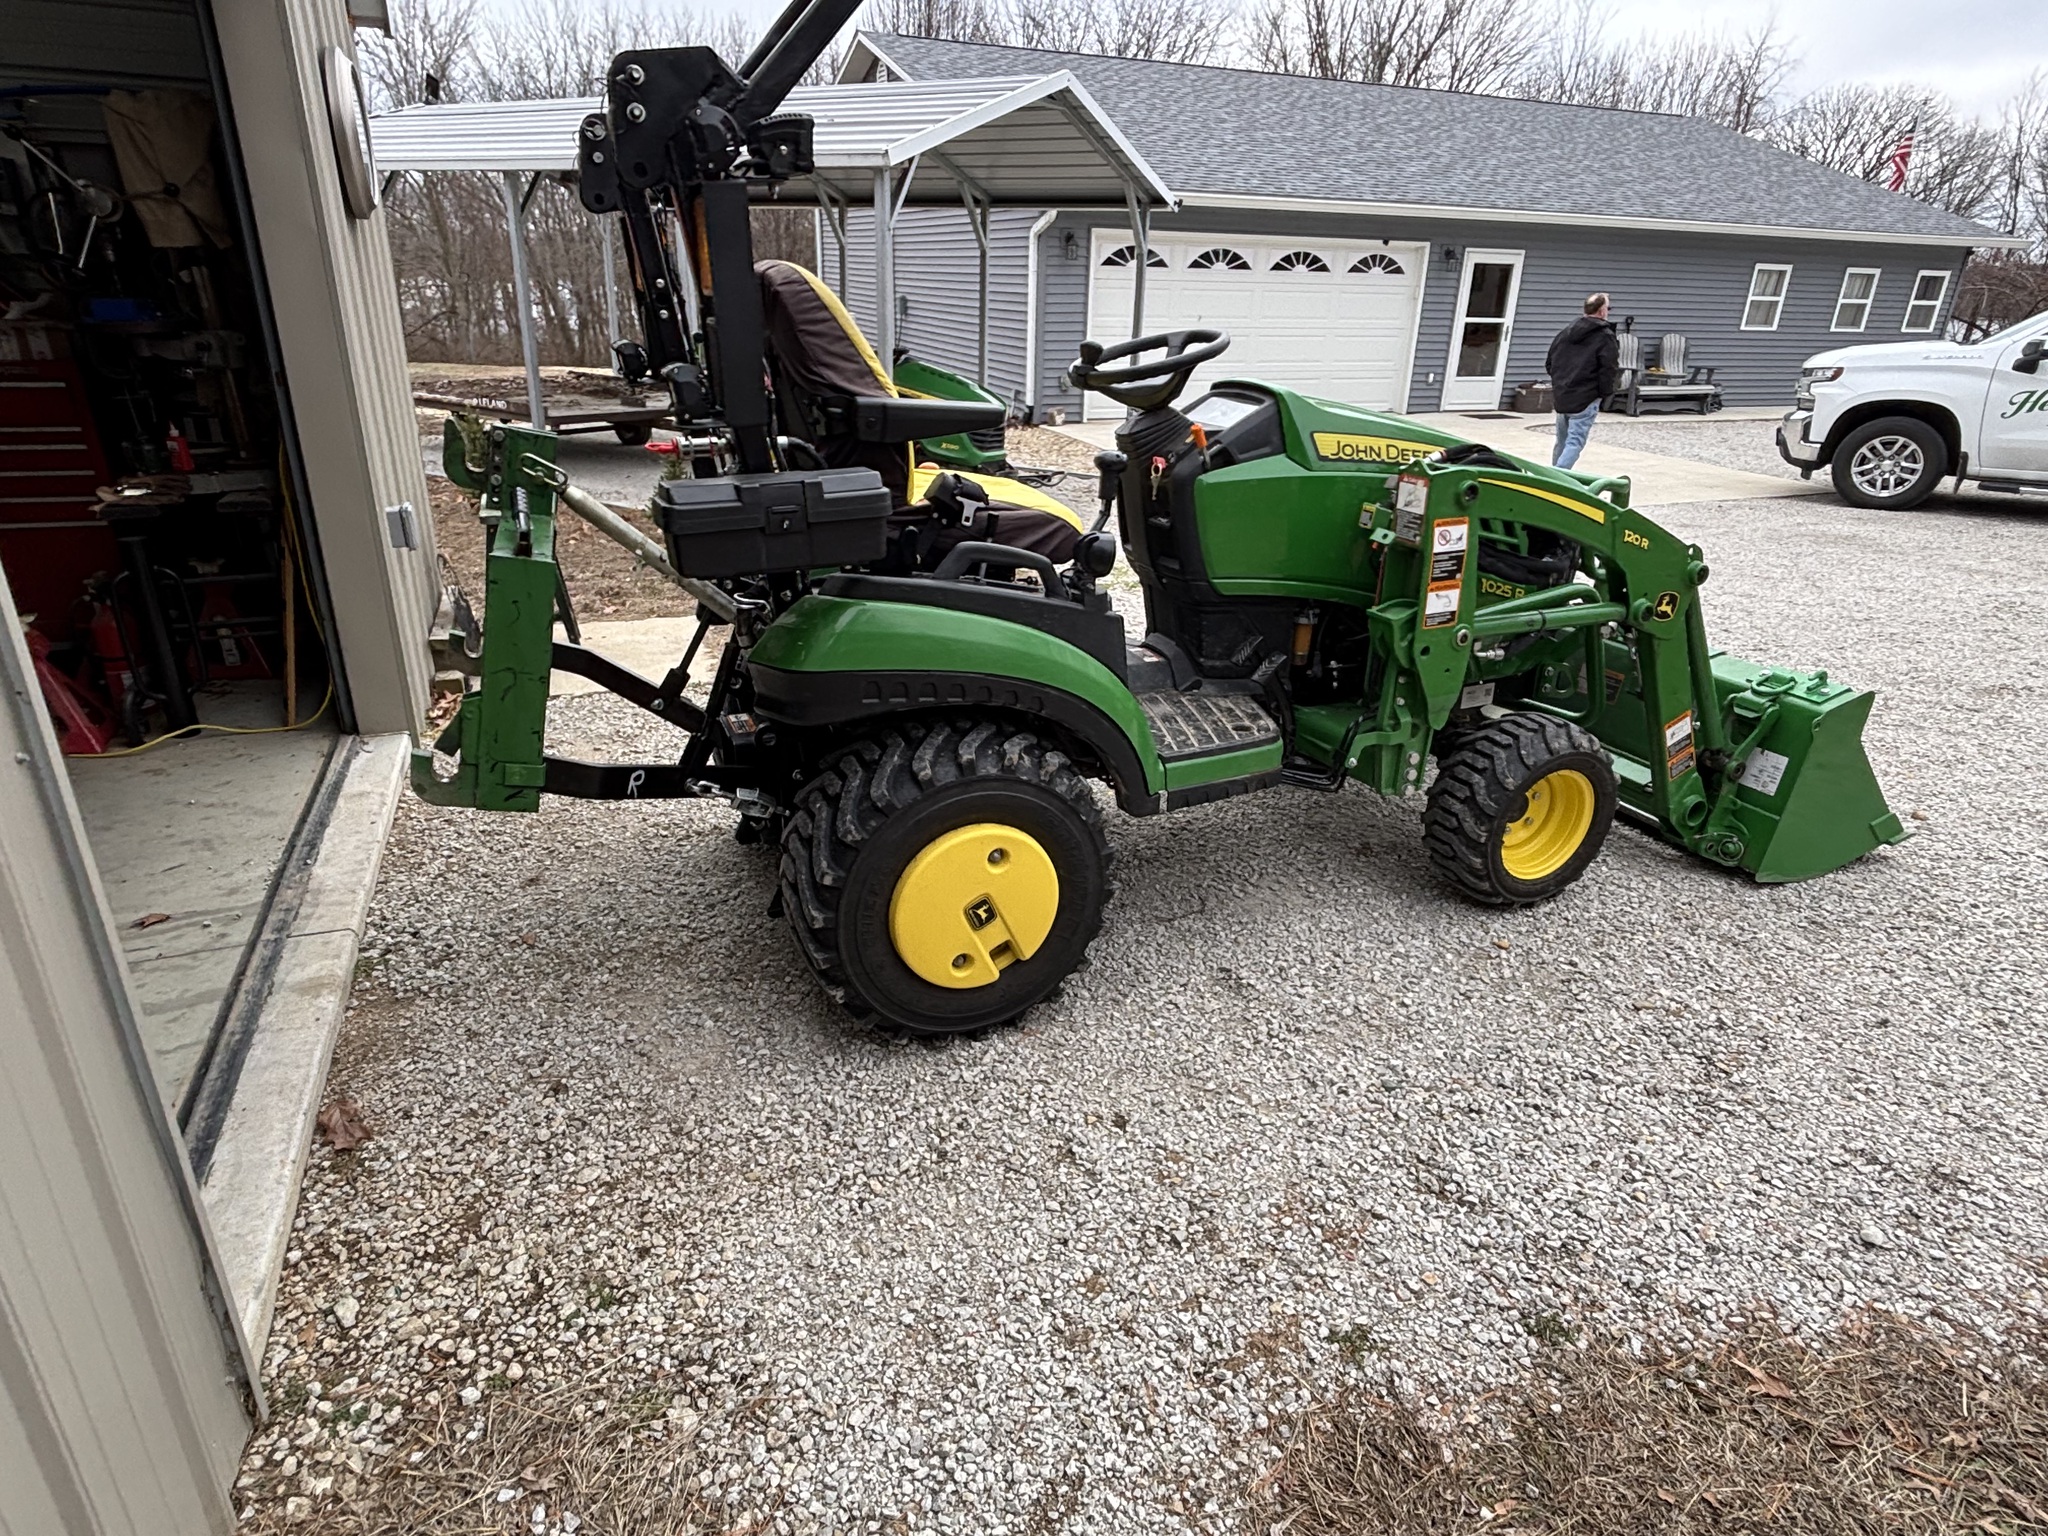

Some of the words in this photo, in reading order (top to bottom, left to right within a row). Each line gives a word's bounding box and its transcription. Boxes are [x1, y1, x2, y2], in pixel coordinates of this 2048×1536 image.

[1330, 440, 1381, 459] JOHN
[1640, 537, 1649, 550] R
[1481, 578, 1513, 598] 1025
[627, 769, 646, 799] R
